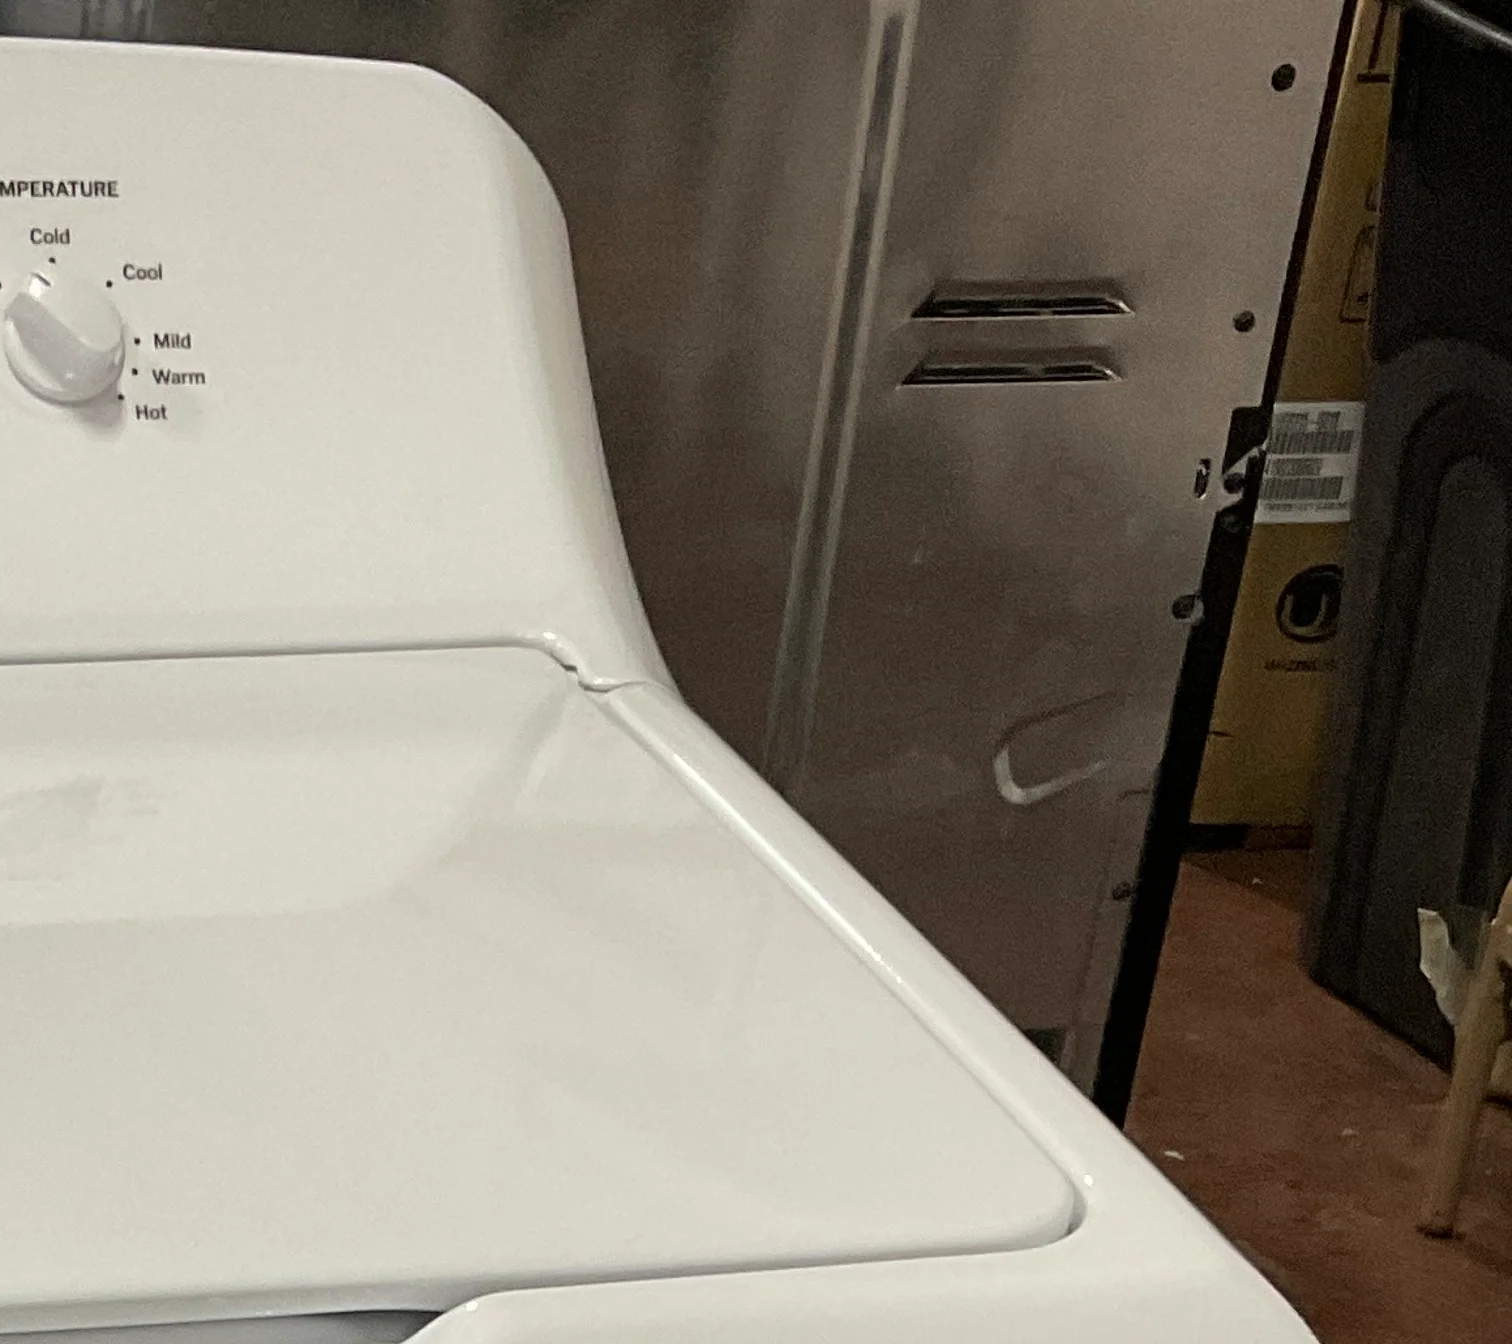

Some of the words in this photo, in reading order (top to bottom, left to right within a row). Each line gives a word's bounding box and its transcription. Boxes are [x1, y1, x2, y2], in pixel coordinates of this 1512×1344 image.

[30, 228, 70, 244] Cold
[123, 263, 162, 280] Cool
[154, 333, 191, 349] Mild
[152, 369, 205, 385] Warm
[135, 404, 167, 420] Hot
